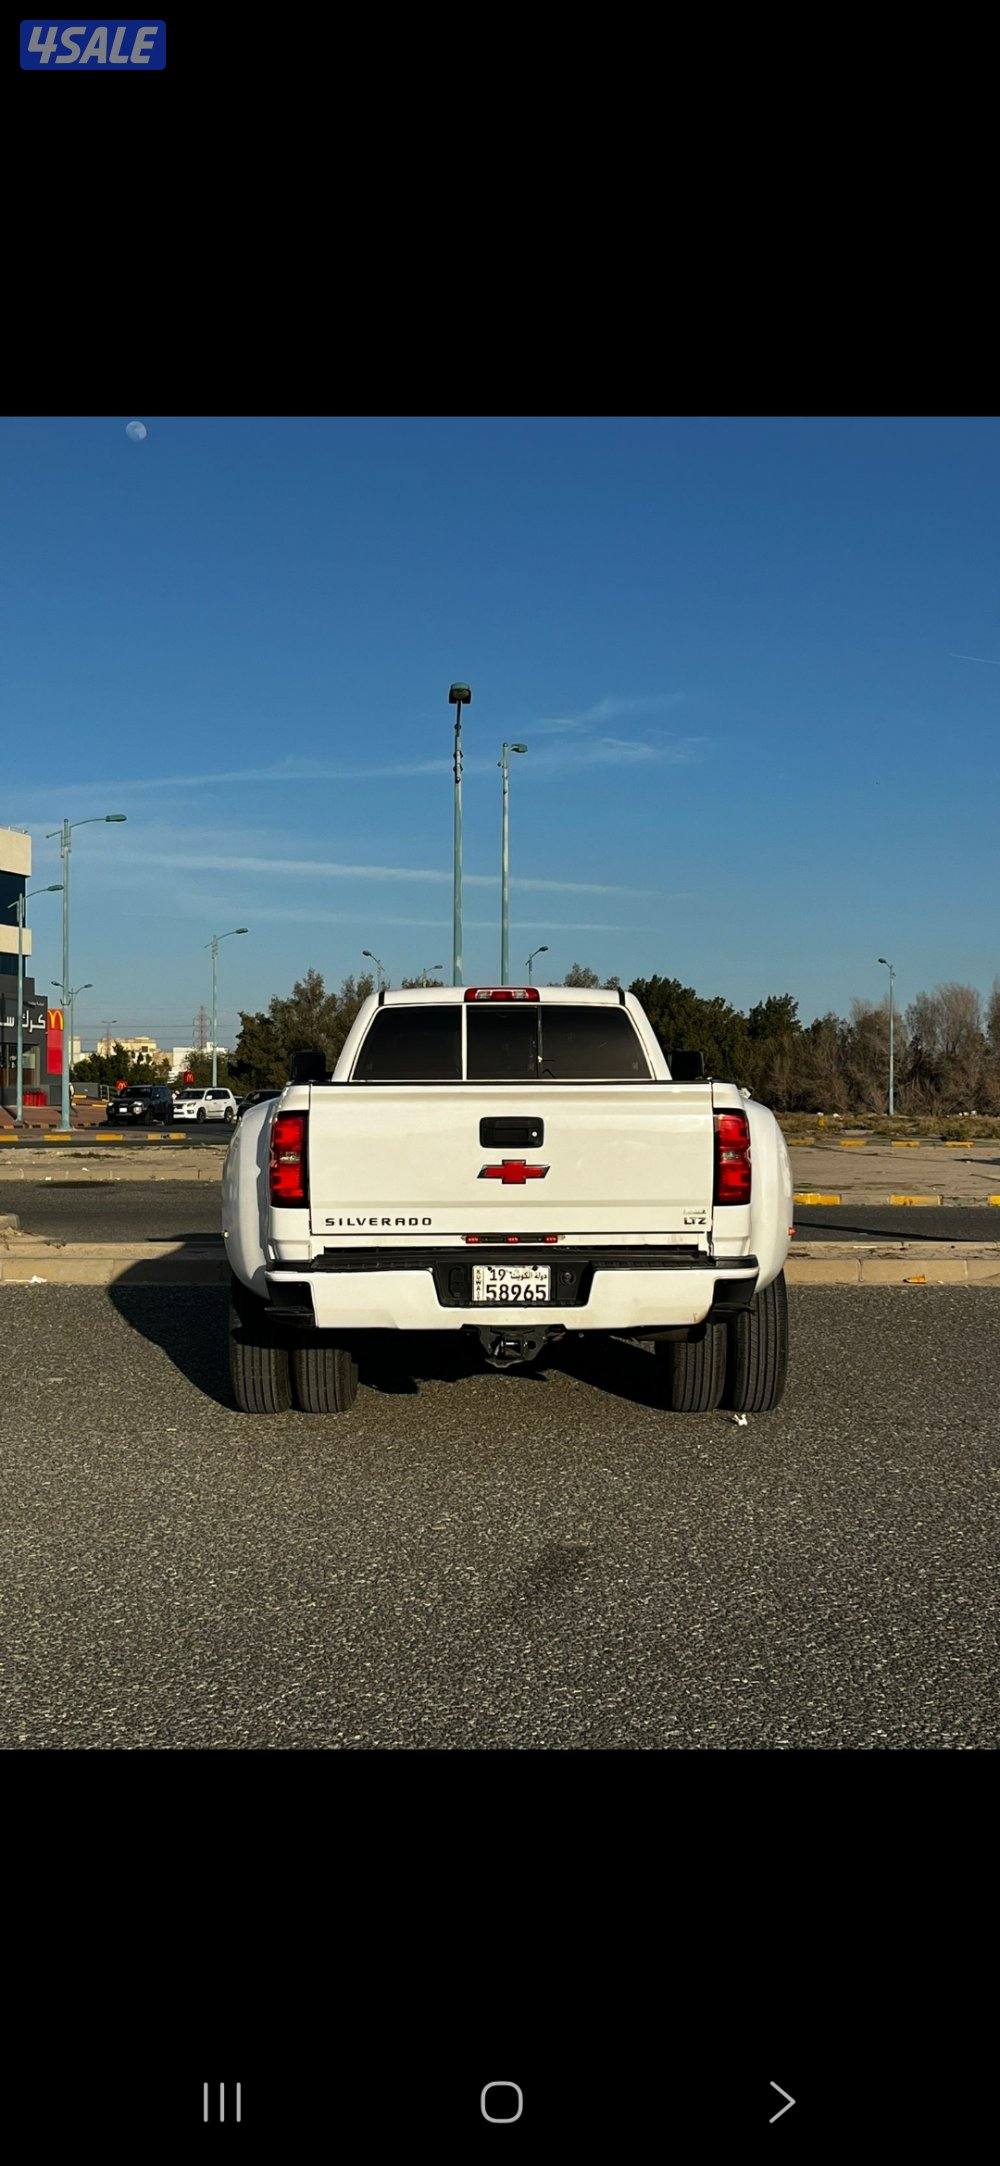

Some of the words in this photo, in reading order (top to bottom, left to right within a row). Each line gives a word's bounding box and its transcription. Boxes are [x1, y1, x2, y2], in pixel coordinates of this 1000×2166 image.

[325, 1217, 432, 1226] SILVERADO
[684, 1217, 706, 1225] LTZ
[489, 1268, 506, 1281] 19
[486, 1284, 546, 1301] 58965
